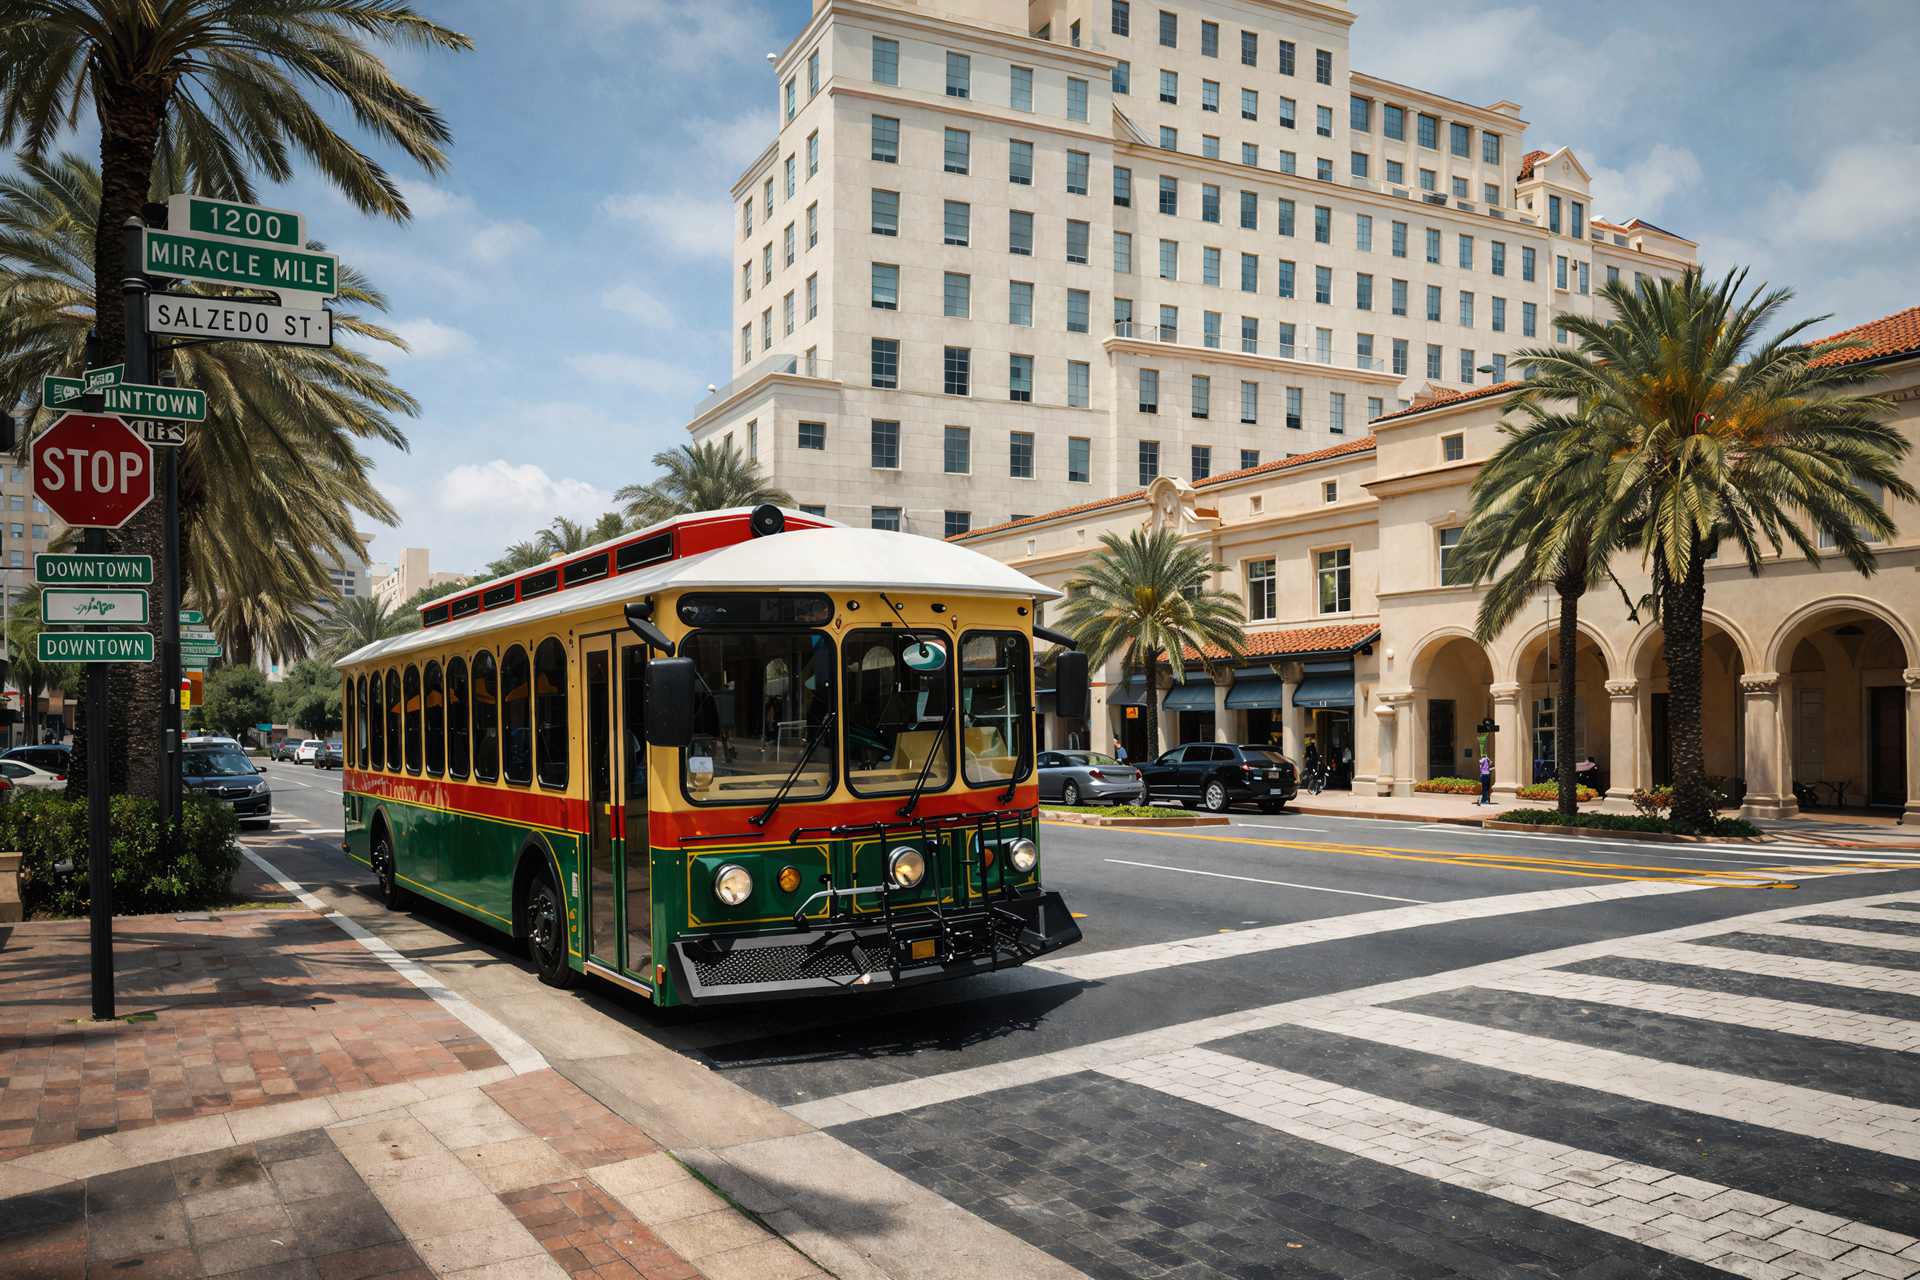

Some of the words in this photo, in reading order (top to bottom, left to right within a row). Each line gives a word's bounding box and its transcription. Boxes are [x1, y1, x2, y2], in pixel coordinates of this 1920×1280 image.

[210, 207, 281, 239] 1200
[151, 240, 261, 277] MIRACLE
[273, 257, 328, 286] MILE
[157, 304, 269, 334] SALZEDO
[42, 447, 143, 494] STOP
[46, 561, 143, 578] DOWNTOWN
[47, 639, 144, 655] DOWNTOWN
